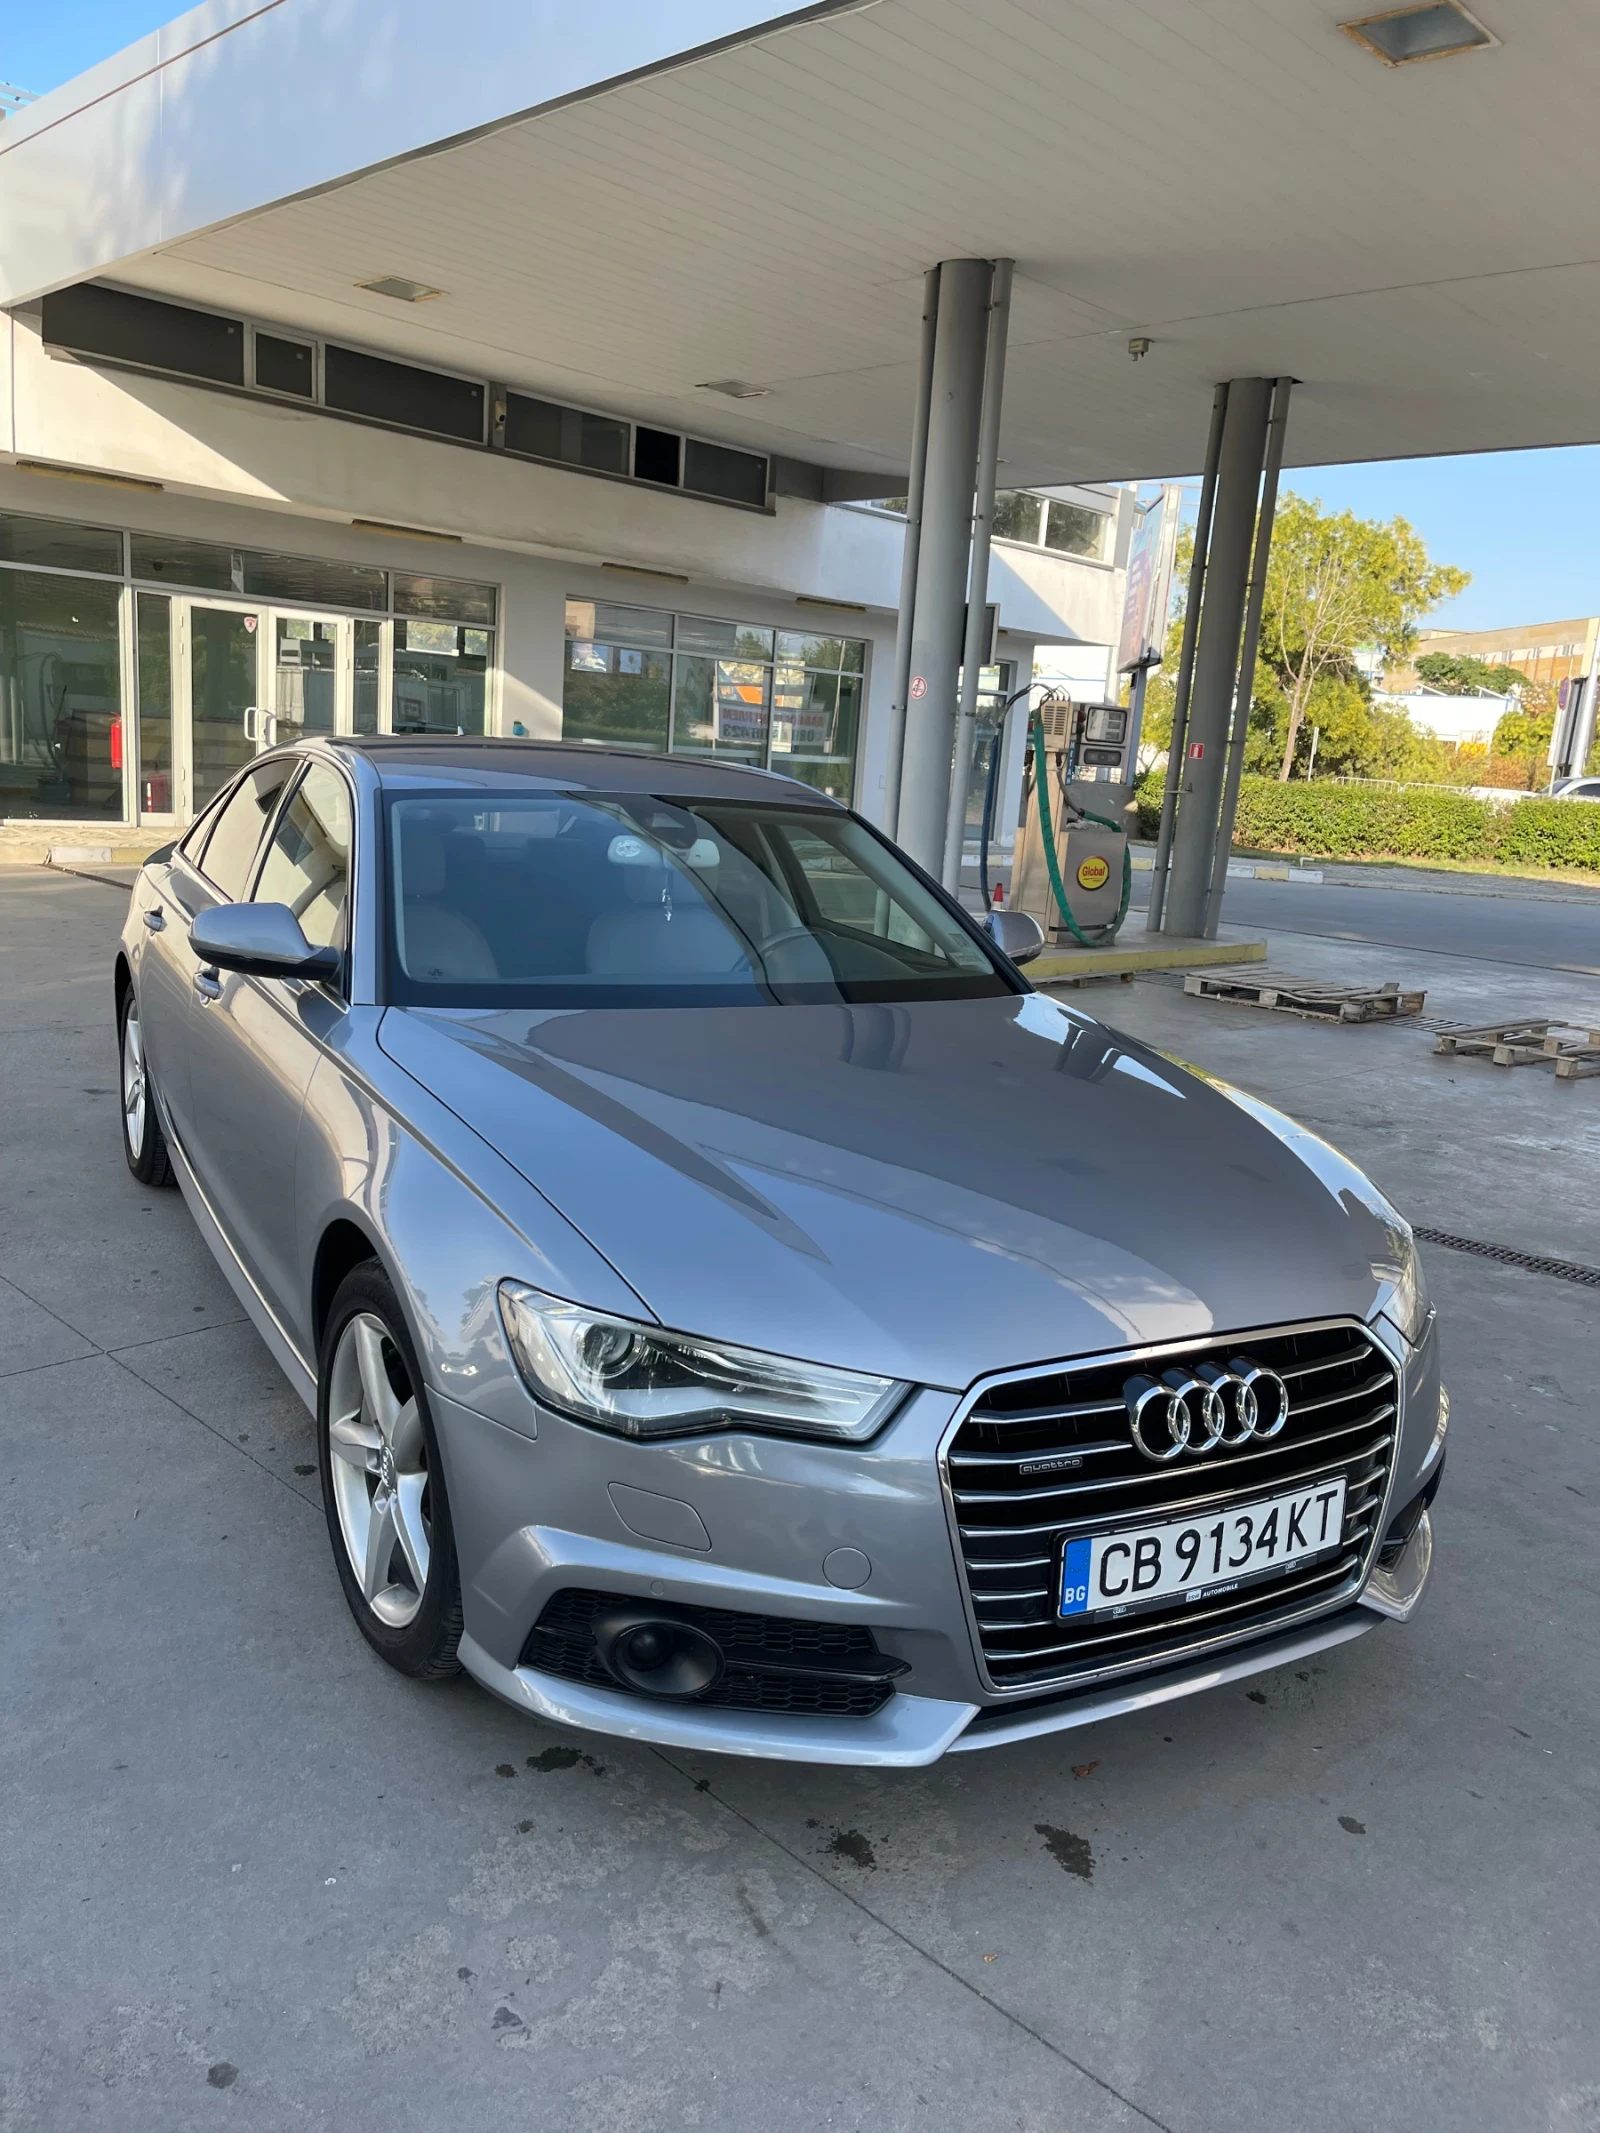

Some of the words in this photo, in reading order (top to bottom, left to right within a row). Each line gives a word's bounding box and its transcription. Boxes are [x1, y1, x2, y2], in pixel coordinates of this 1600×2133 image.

[1082, 865, 1106, 877] Global
[1023, 1459, 1081, 1472] quattro
[1099, 1537, 1162, 1597] CB
[1175, 1507, 1279, 1582] 9134
[1286, 1489, 1338, 1552] KT
[1065, 1585, 1086, 1604] BG
[1202, 1583, 1239, 1598] AUTOMOBILE
